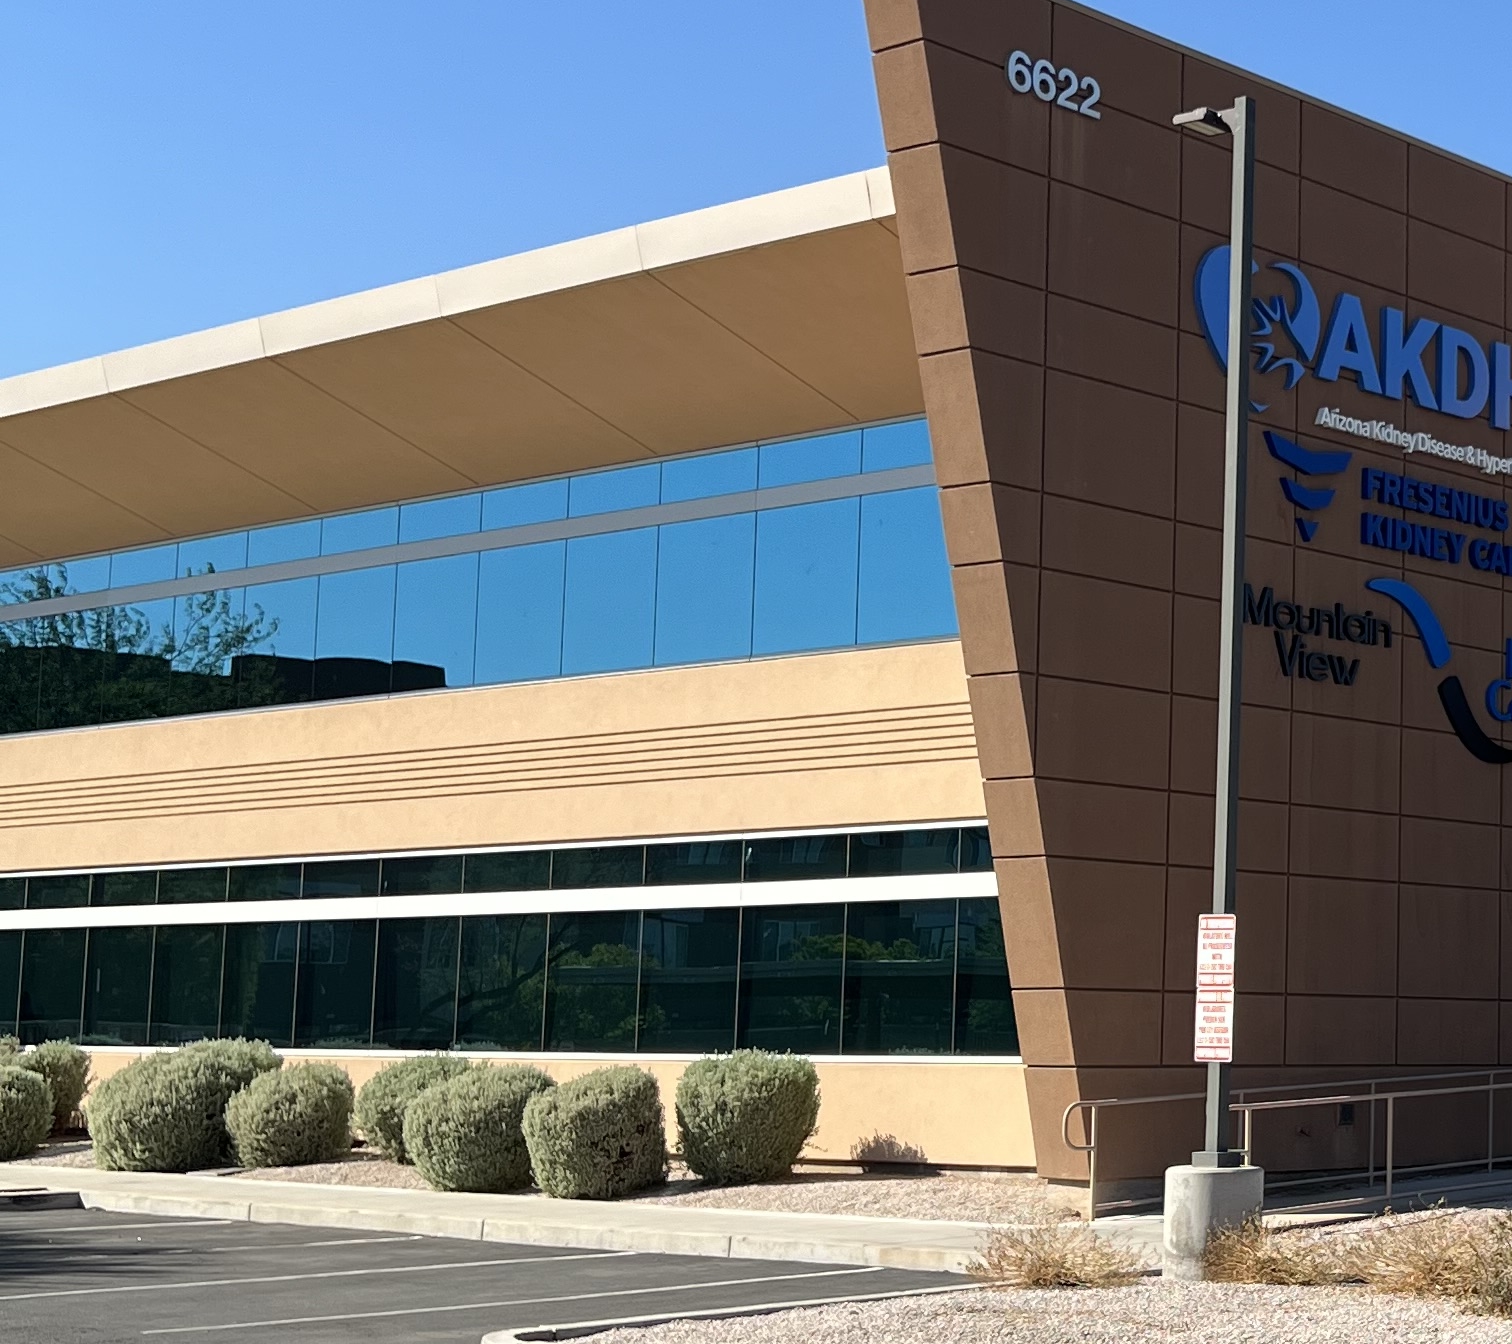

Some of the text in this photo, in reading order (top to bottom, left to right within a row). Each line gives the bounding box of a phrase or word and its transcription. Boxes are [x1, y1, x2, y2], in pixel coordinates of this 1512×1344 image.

[1007, 50, 1101, 120] 6622
[1315, 407, 1370, 438] Arizona
[1372, 420, 1416, 453] Kidney
[1418, 432, 1464, 460] Disease
[1466, 446, 1475, 464] &
[1361, 467, 1510, 532] FRESENIUS
[1361, 512, 1467, 564] KIDNEY
[1243, 583, 1393, 648] Mountain
[1274, 630, 1360, 686] View
